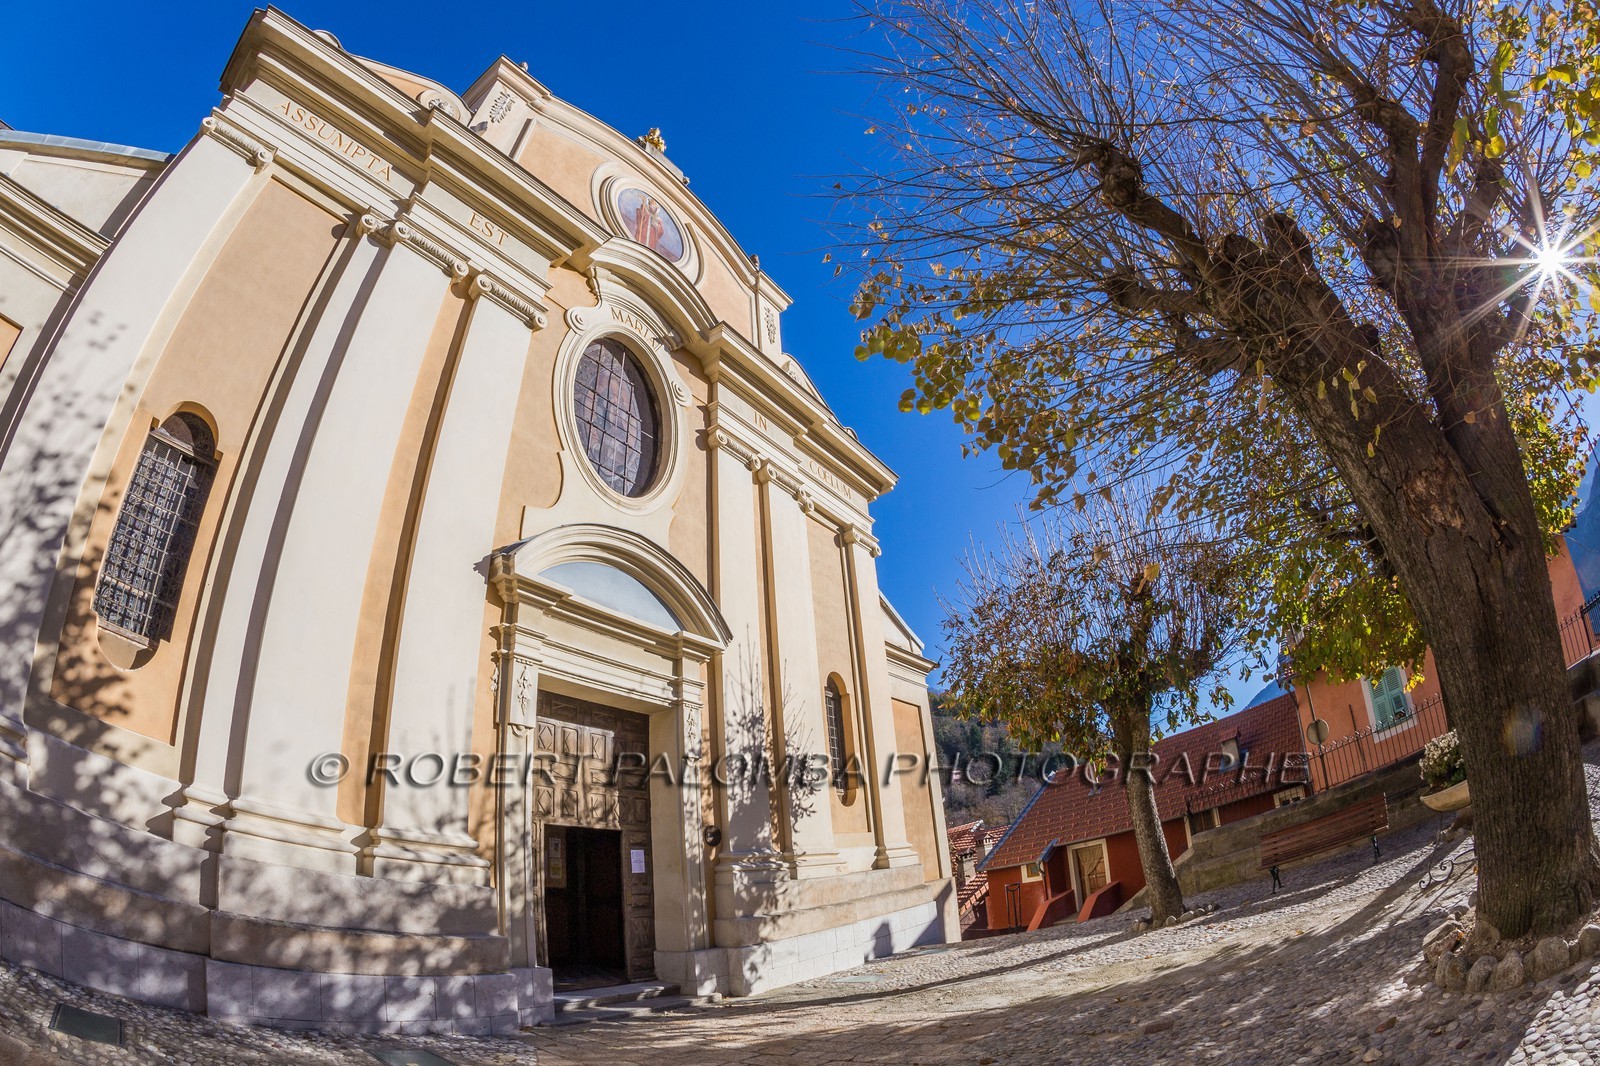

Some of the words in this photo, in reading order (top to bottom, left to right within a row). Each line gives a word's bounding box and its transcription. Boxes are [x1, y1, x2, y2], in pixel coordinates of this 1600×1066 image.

[276, 100, 392, 182] ASSUMPTA
[468, 211, 510, 247] EST
[754, 411, 768, 432] IN
